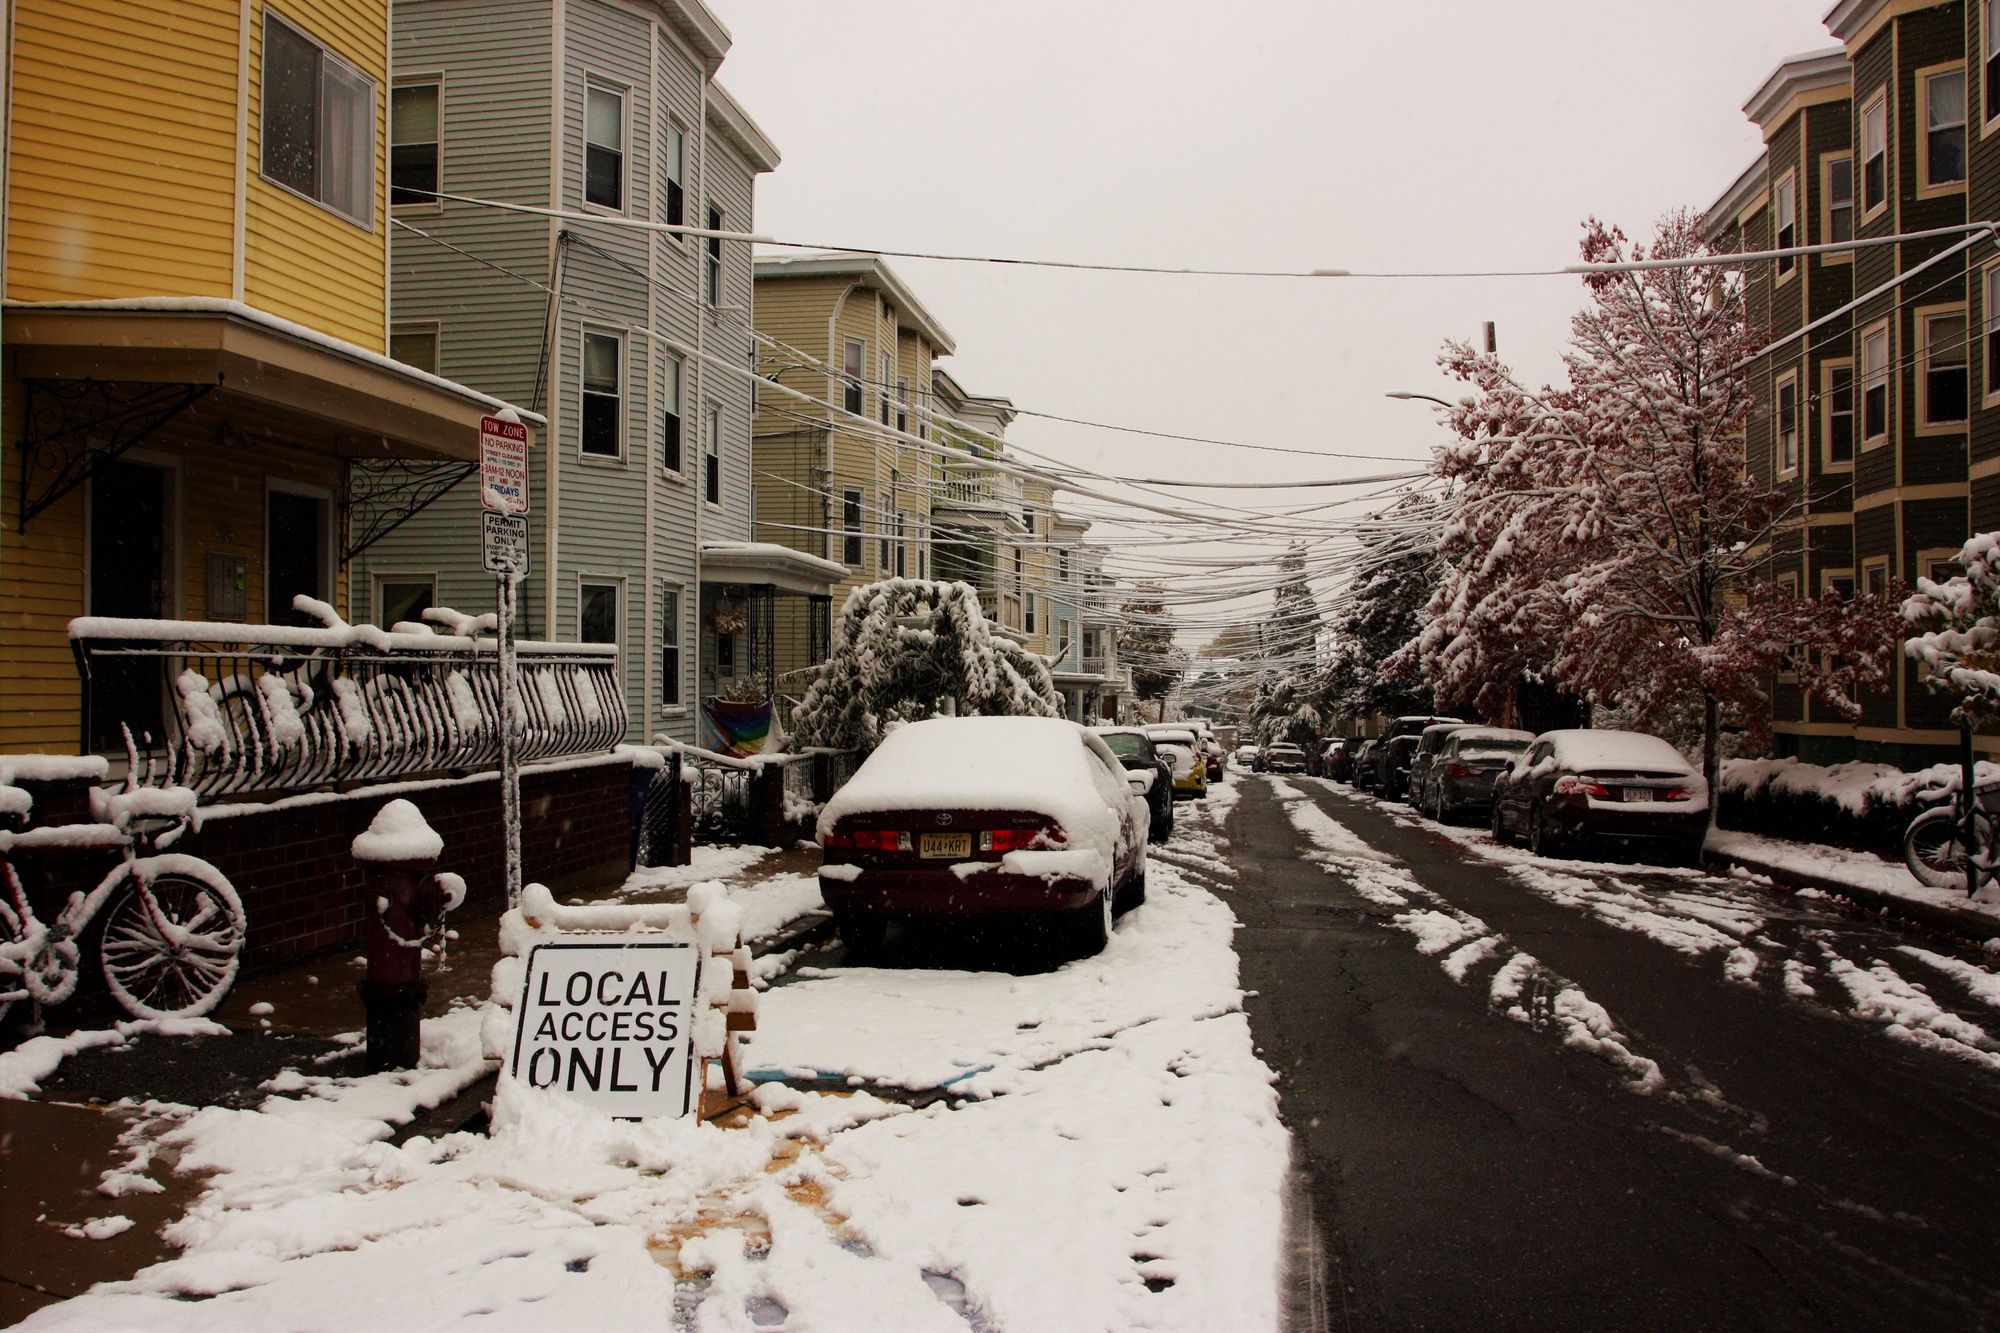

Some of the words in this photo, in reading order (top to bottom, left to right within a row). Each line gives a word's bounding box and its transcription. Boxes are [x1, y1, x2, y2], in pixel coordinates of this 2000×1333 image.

[484, 420, 499, 433] TOW
[503, 425, 525, 438] ZONE
[485, 437, 494, 447] NO
[496, 442, 523, 453] PARKING
[485, 449, 501, 457] STREET
[502, 453, 523, 461] CLEANING
[506, 470, 524, 480] NOON
[490, 484, 520, 497] FRIDAYS
[489, 517, 521, 528] PERMIT
[486, 526, 524, 538] PARKING
[494, 536, 517, 546] ONLY
[538, 971, 681, 1006] LOCAL
[533, 1012, 678, 1042] ACCESS
[528, 1047, 676, 1092] ONLY
